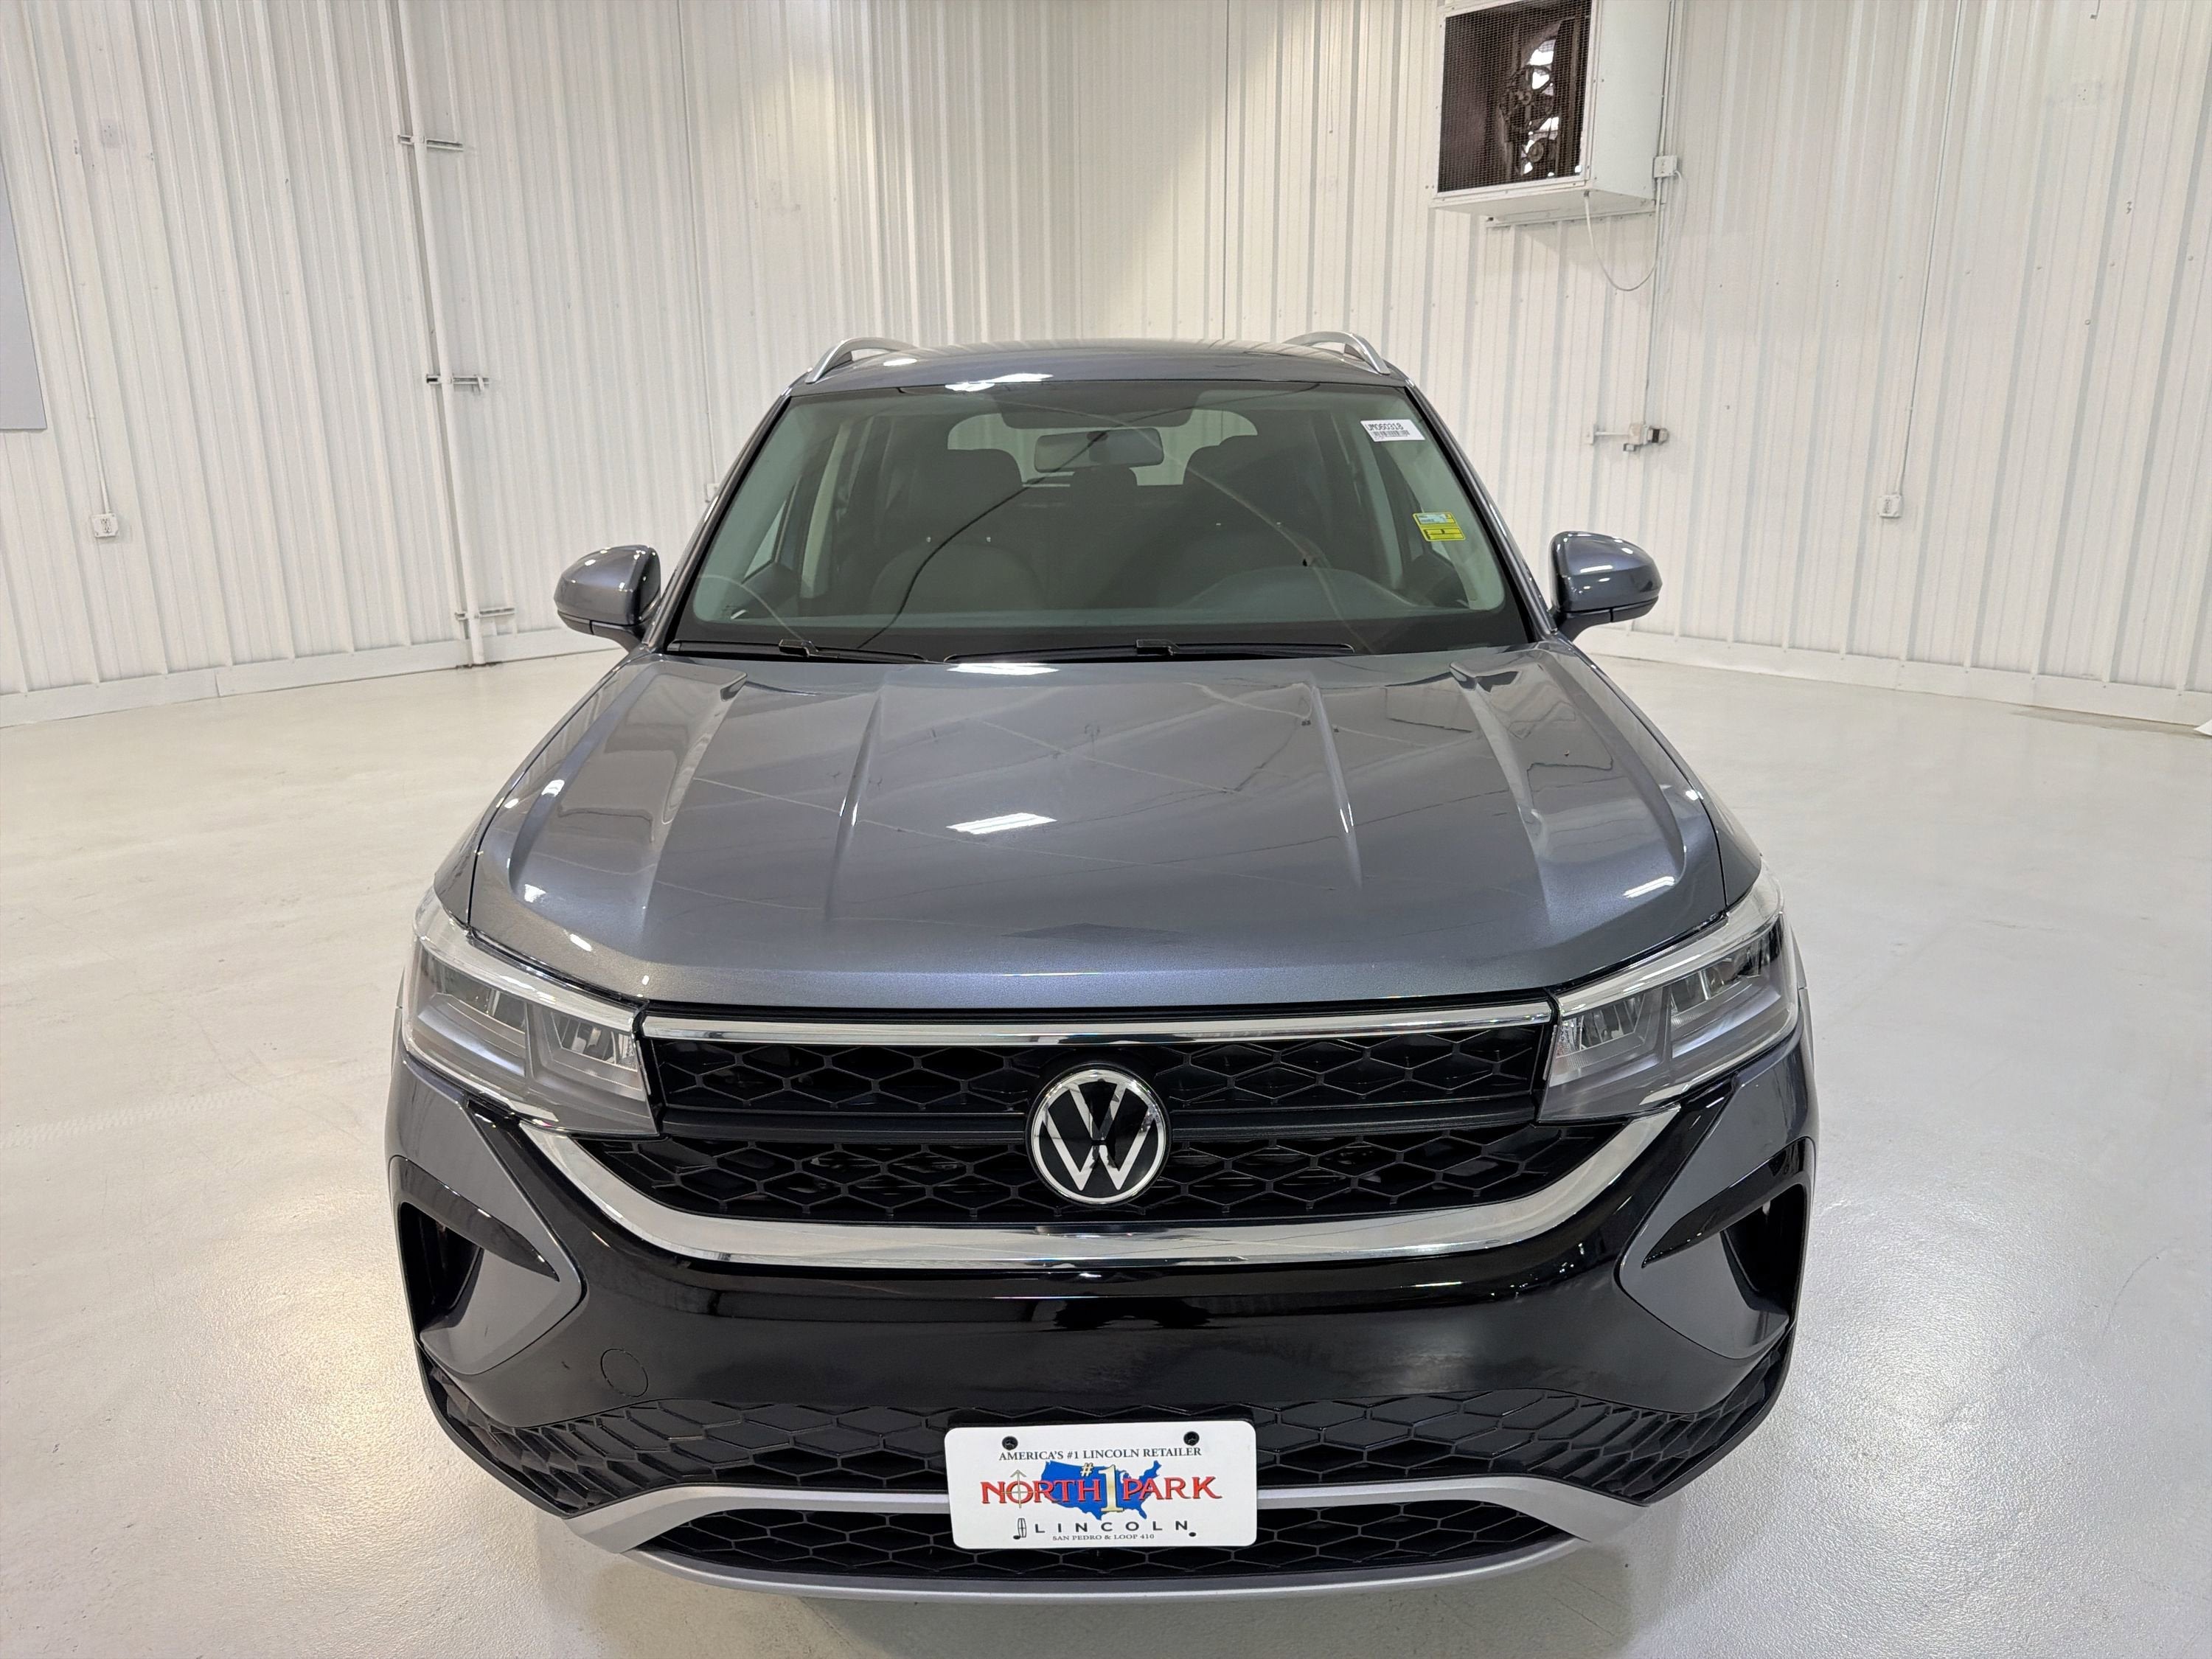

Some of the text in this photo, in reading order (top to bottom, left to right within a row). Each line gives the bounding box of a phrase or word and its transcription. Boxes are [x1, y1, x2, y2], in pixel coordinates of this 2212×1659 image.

[998, 1447, 1202, 1461] AMERICA'S #1 LINCOLN RETAILER
[980, 1478, 1102, 1504] NORTH
[1122, 1476, 1223, 1501] PARK
[1035, 1520, 1188, 1534] LINCOLN
